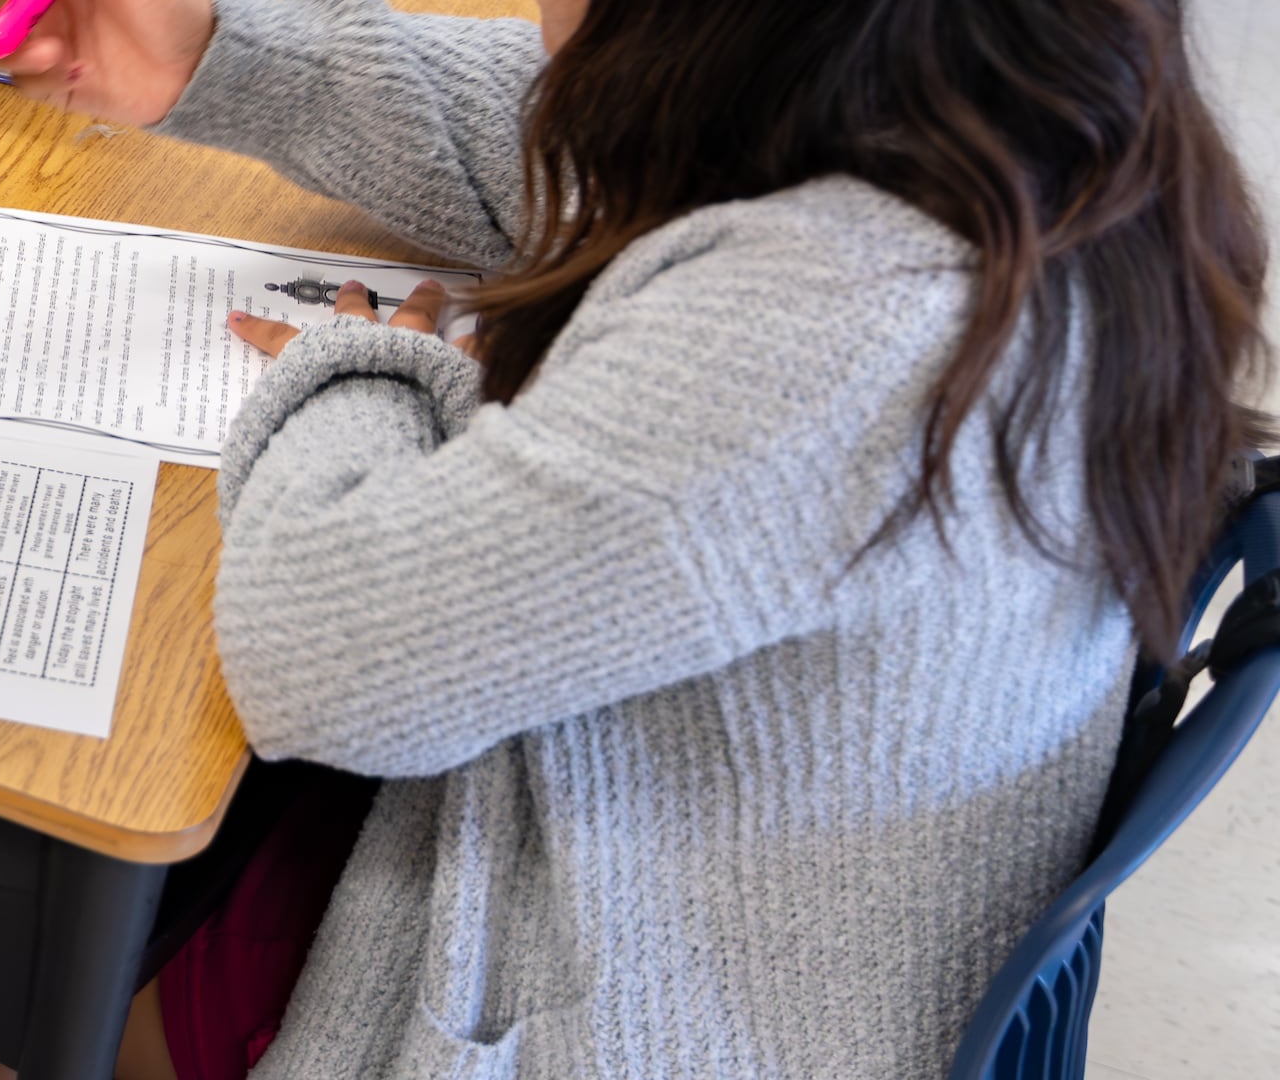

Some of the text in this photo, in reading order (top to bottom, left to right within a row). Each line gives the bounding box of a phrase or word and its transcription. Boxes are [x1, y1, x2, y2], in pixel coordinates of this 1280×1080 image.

[75, 492, 105, 561] There were many
[96, 534, 112, 575] accidents
[52, 643, 73, 668] Today
[65, 585, 84, 624] stoplight
[84, 609, 100, 632] many
[78, 634, 93, 660] saves
[74, 661, 87, 679] still
